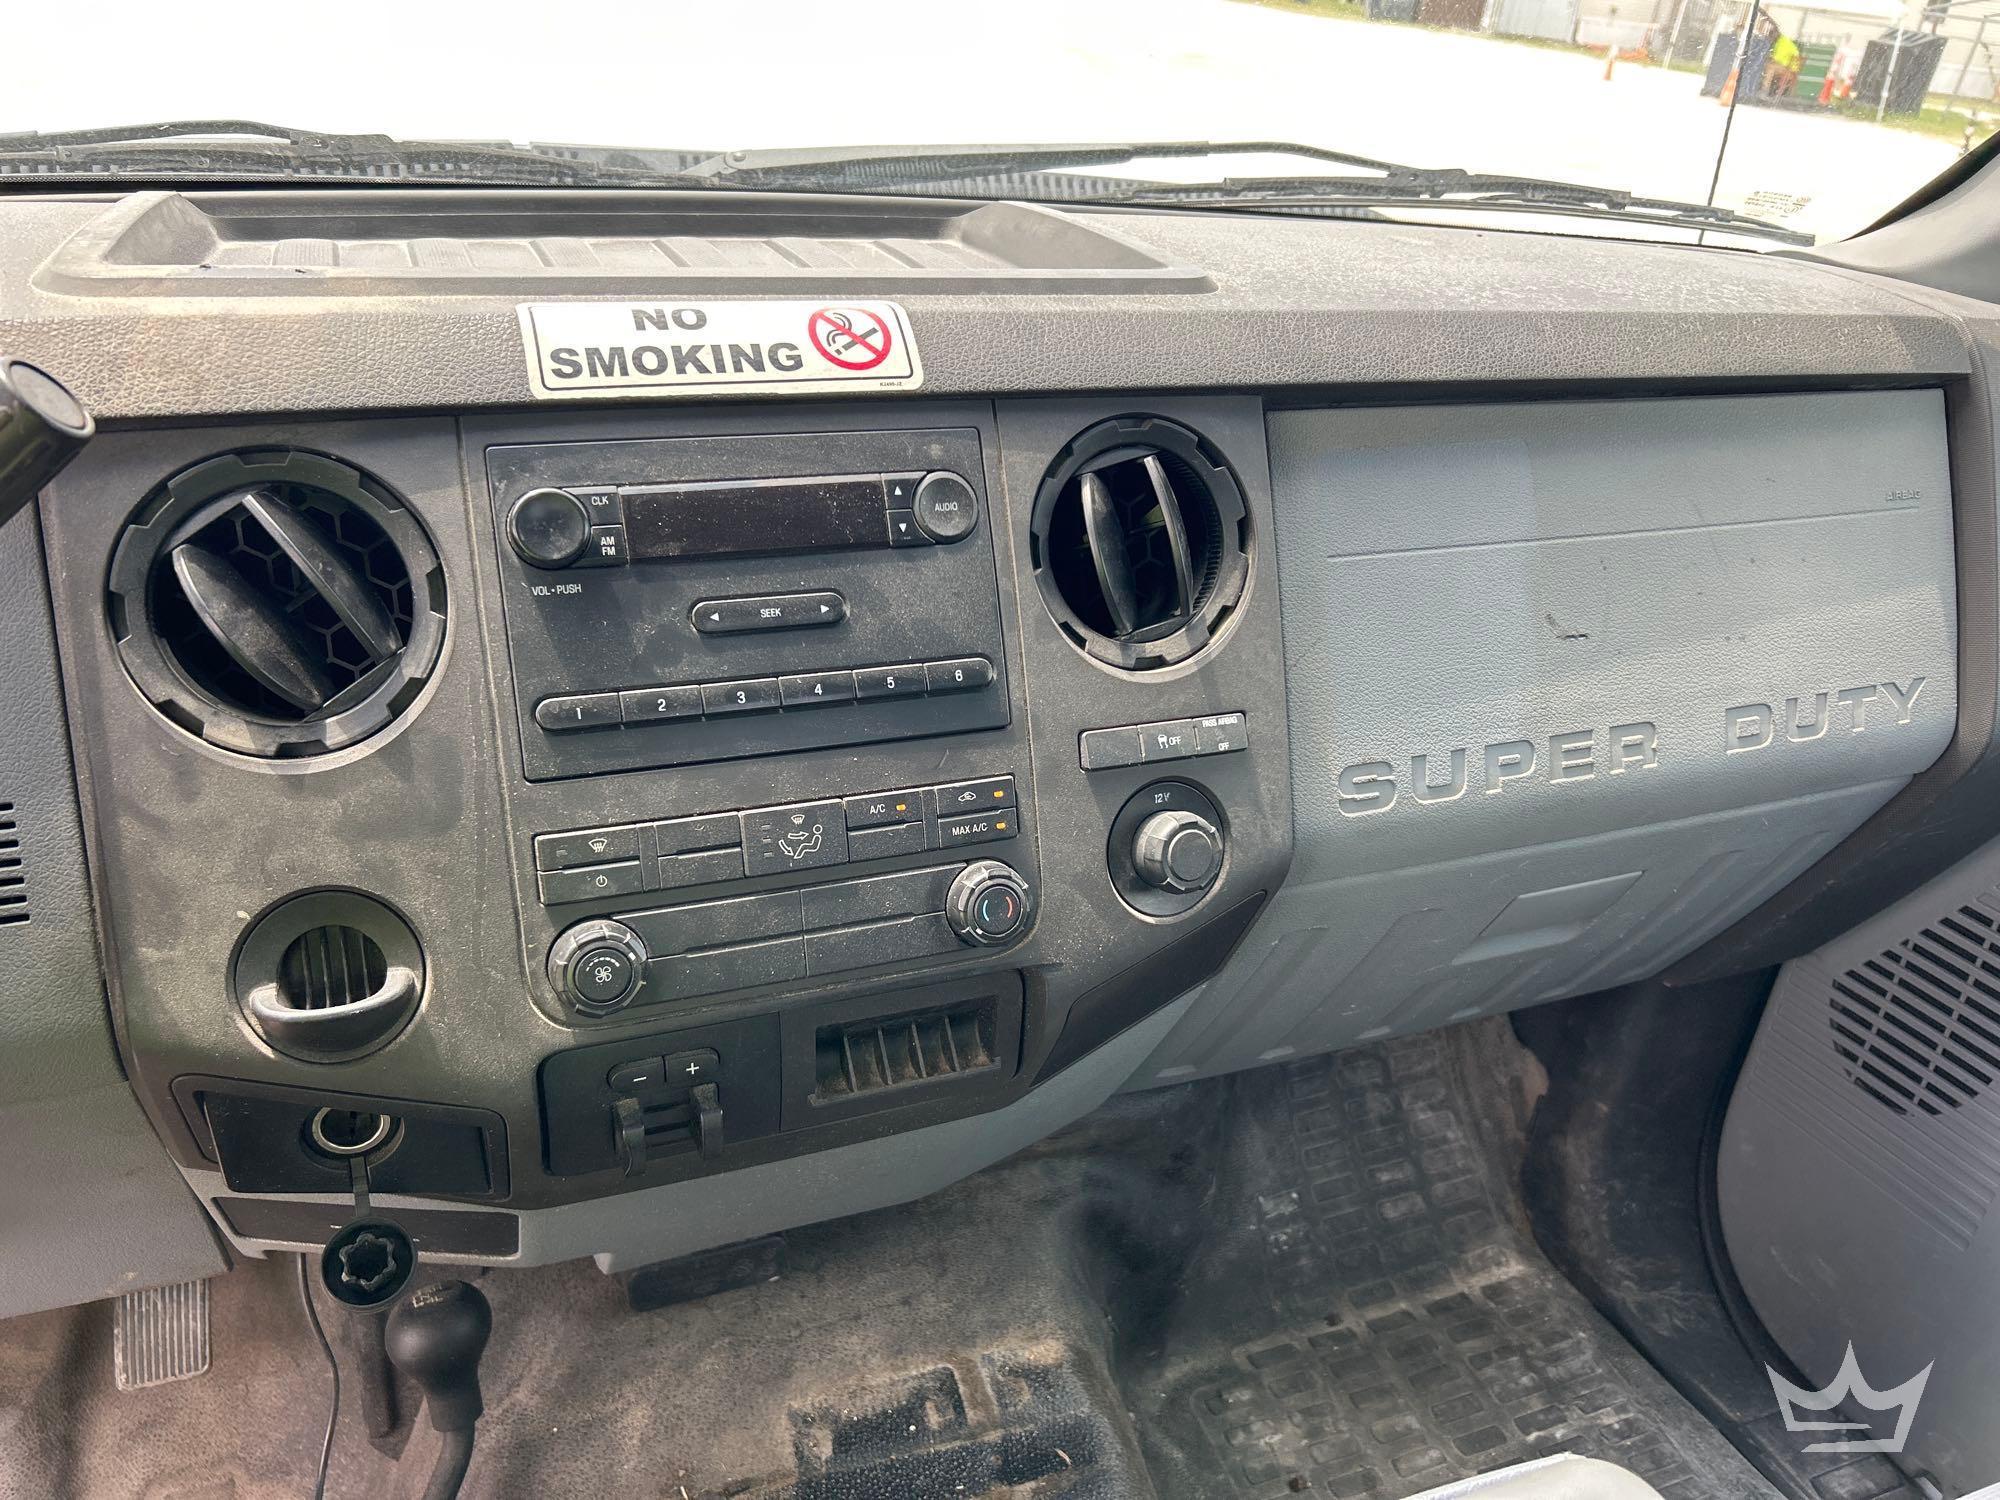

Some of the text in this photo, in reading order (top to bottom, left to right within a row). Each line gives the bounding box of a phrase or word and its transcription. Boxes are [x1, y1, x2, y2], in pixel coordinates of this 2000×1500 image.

[631, 308, 707, 331] NO
[549, 341, 804, 379] SMOKING
[591, 496, 609, 506] CLK
[934, 501, 958, 512] AUDIO
[600, 536, 615, 546] AM
[602, 546, 616, 556] FM
[760, 607, 782, 618] SEEK
[575, 669, 964, 720] 1 2 3 4 5 6
[1169, 736, 1182, 746] OFF
[1218, 742, 1230, 751] OFF
[1337, 676, 1927, 817] SUPER DUTY
[1154, 792, 1171, 804] 12V
[869, 803, 886, 815] A/C
[951, 823, 988, 836] MAX A/C
